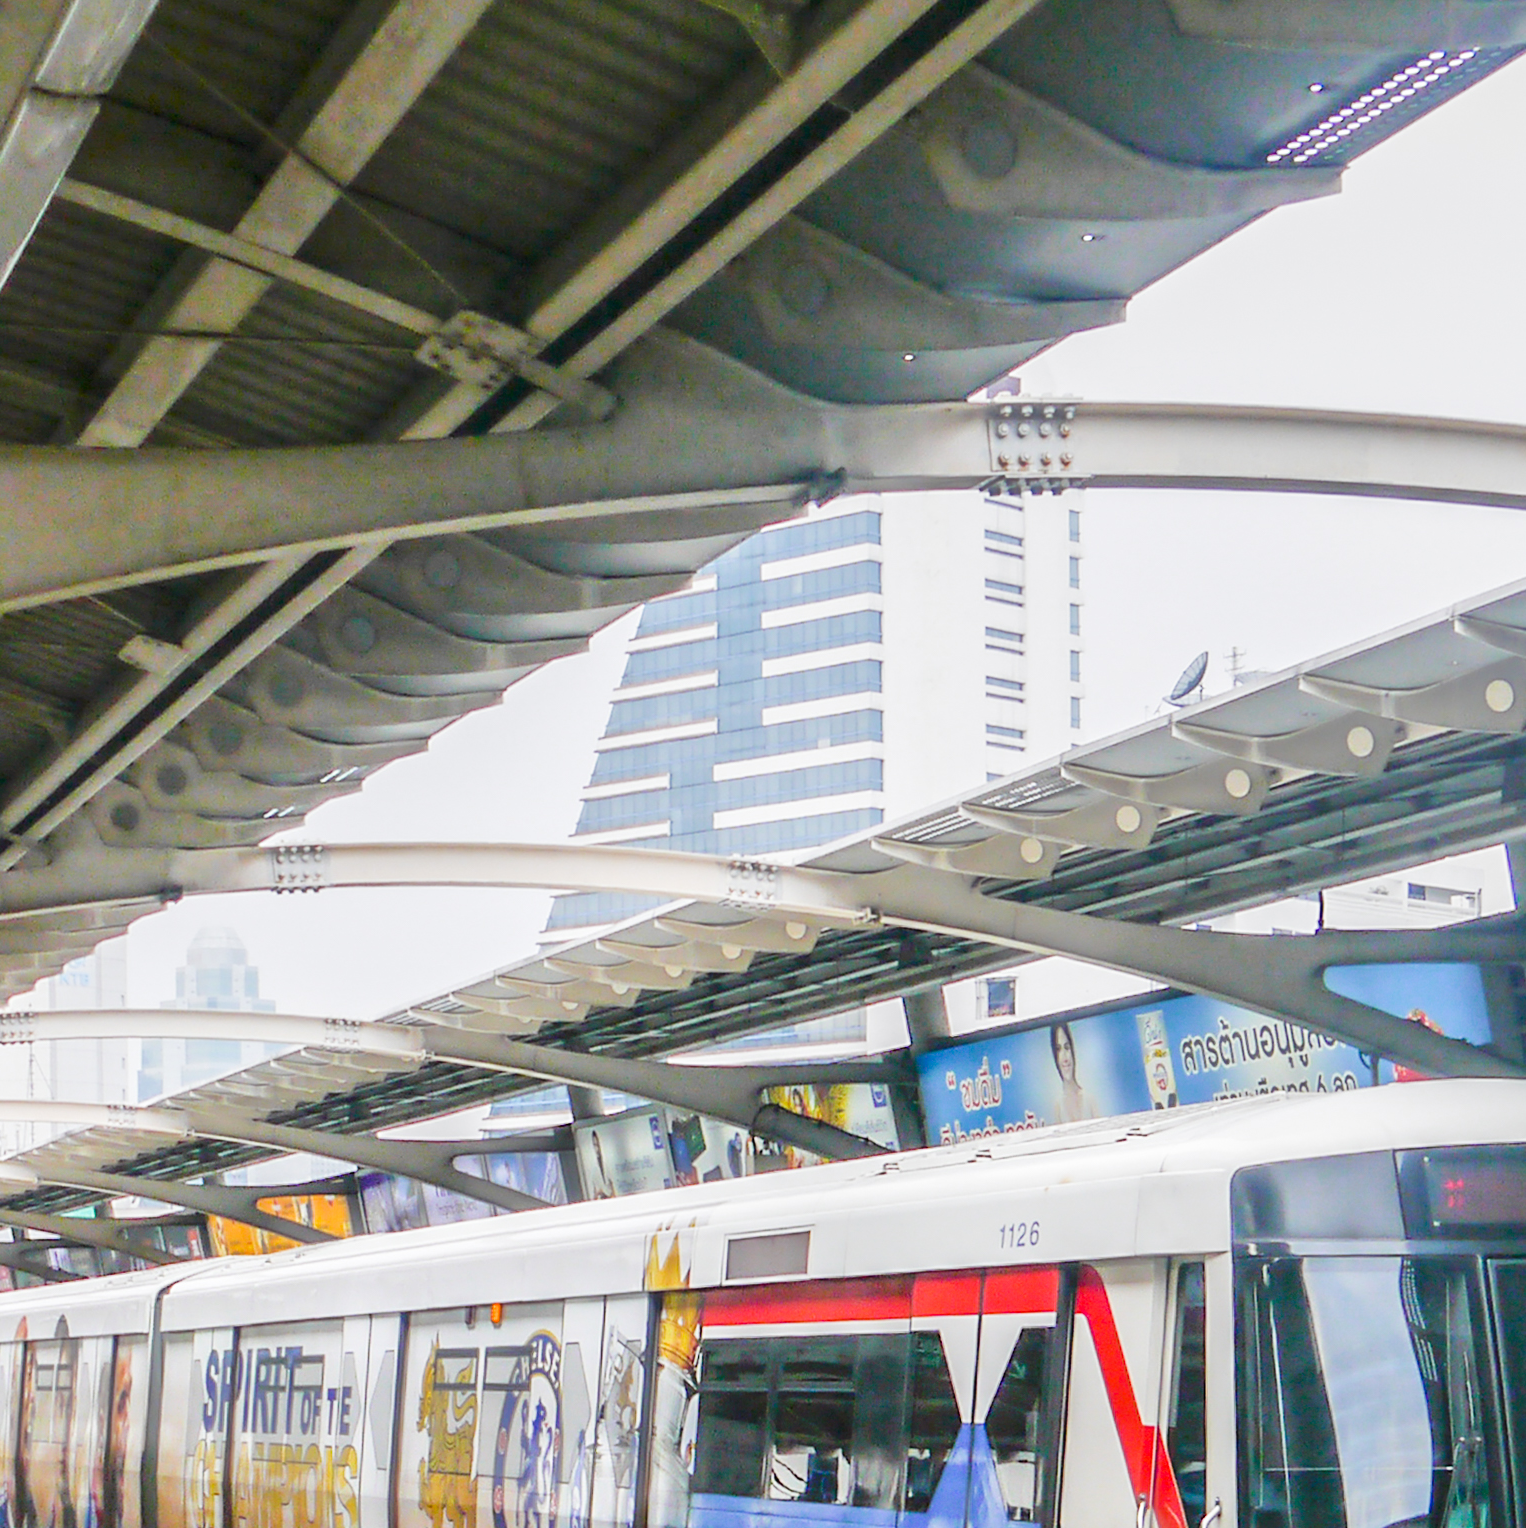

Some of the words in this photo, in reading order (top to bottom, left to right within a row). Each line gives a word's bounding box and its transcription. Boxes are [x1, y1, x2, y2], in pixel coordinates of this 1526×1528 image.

[1000, 1221, 1040, 1249] 1126
[202, 1346, 304, 1435] SPIRIT
[299, 1387, 323, 1436] OF
